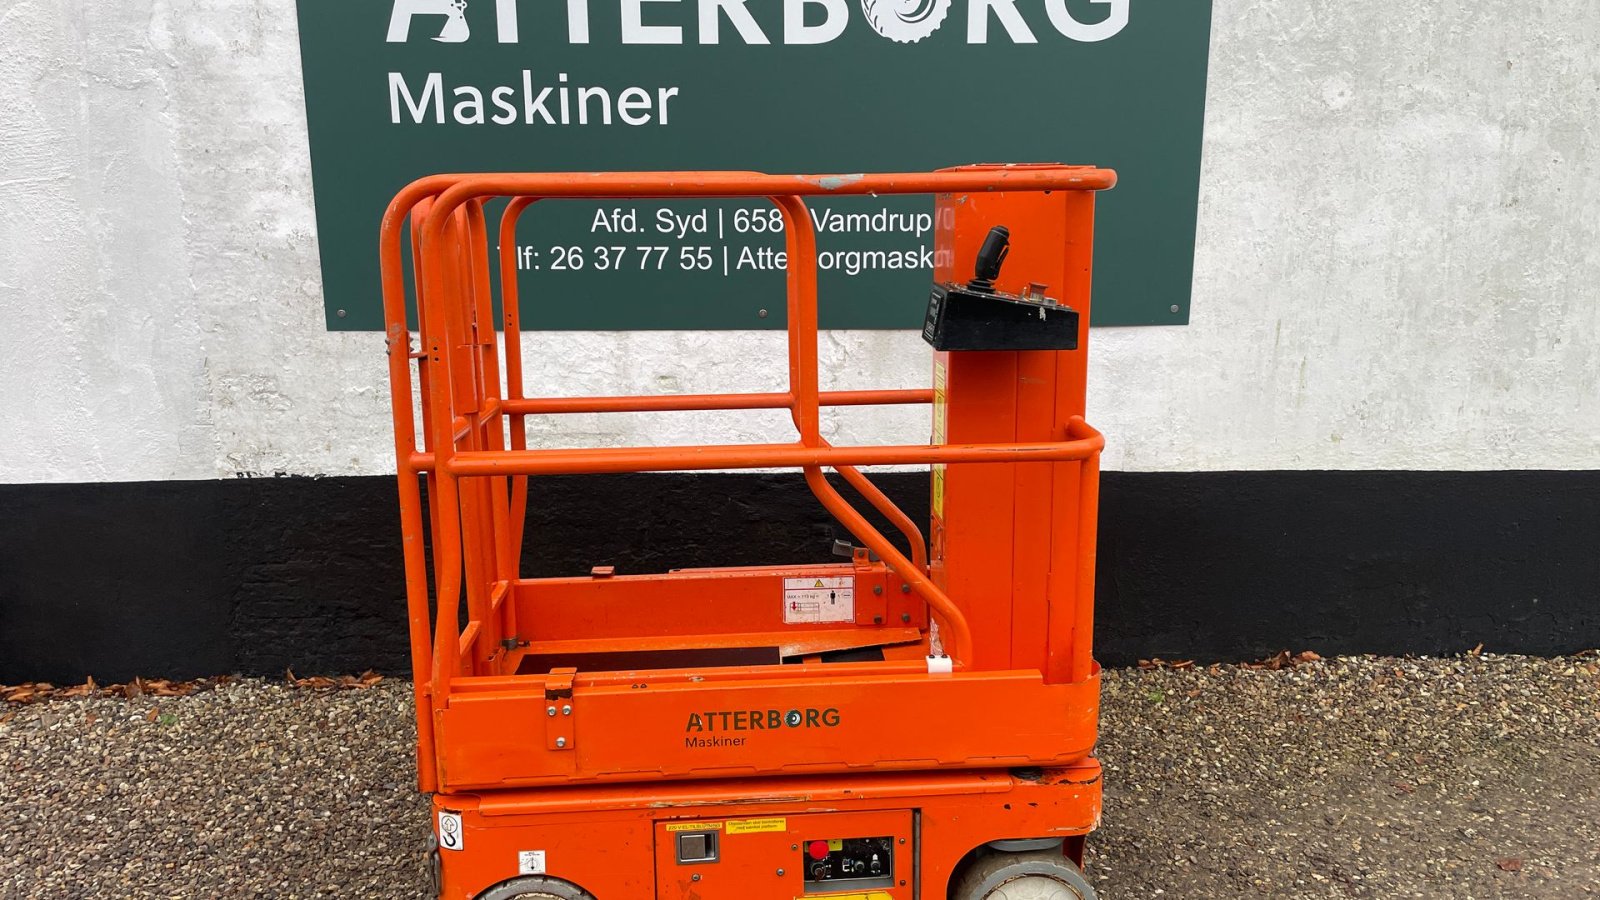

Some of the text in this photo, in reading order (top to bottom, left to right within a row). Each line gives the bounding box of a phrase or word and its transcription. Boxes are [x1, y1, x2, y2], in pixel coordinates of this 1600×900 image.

[388, 69, 679, 125] Maskiner
[591, 208, 645, 233] Afd.
[655, 208, 707, 239] Syd
[733, 208, 784, 233] 658
[809, 207, 932, 238] Vamdrup
[550, 246, 584, 270] 26
[593, 246, 627, 270] 37
[636, 246, 670, 270] 77
[680, 246, 713, 270] 55
[686, 708, 840, 732] ATTERBORG
[685, 735, 746, 748] Maskiner
